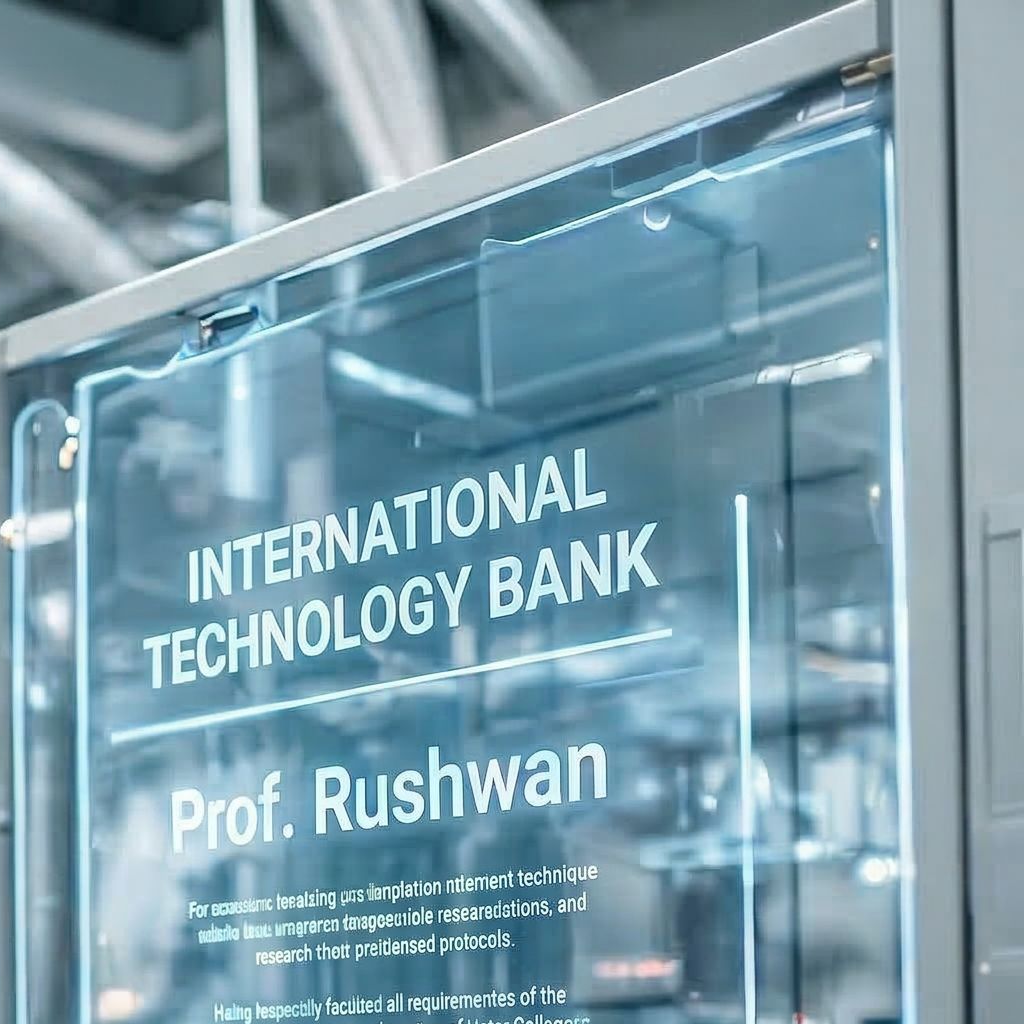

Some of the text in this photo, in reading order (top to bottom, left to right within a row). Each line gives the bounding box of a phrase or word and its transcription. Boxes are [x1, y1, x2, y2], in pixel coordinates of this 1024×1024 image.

[188, 448, 607, 604] INTERNATIONAL
[143, 522, 660, 689] TECHNOLOGY BANK
[171, 742, 608, 853] Prof. Rushwan
[189, 901, 209, 919] For
[517, 864, 598, 887] technique
[557, 891, 587, 914] and
[256, 942, 312, 965] research
[439, 929, 515, 956] protocols.
[386, 993, 403, 1013] all
[520, 986, 536, 1006] of
[540, 985, 567, 1005] the
